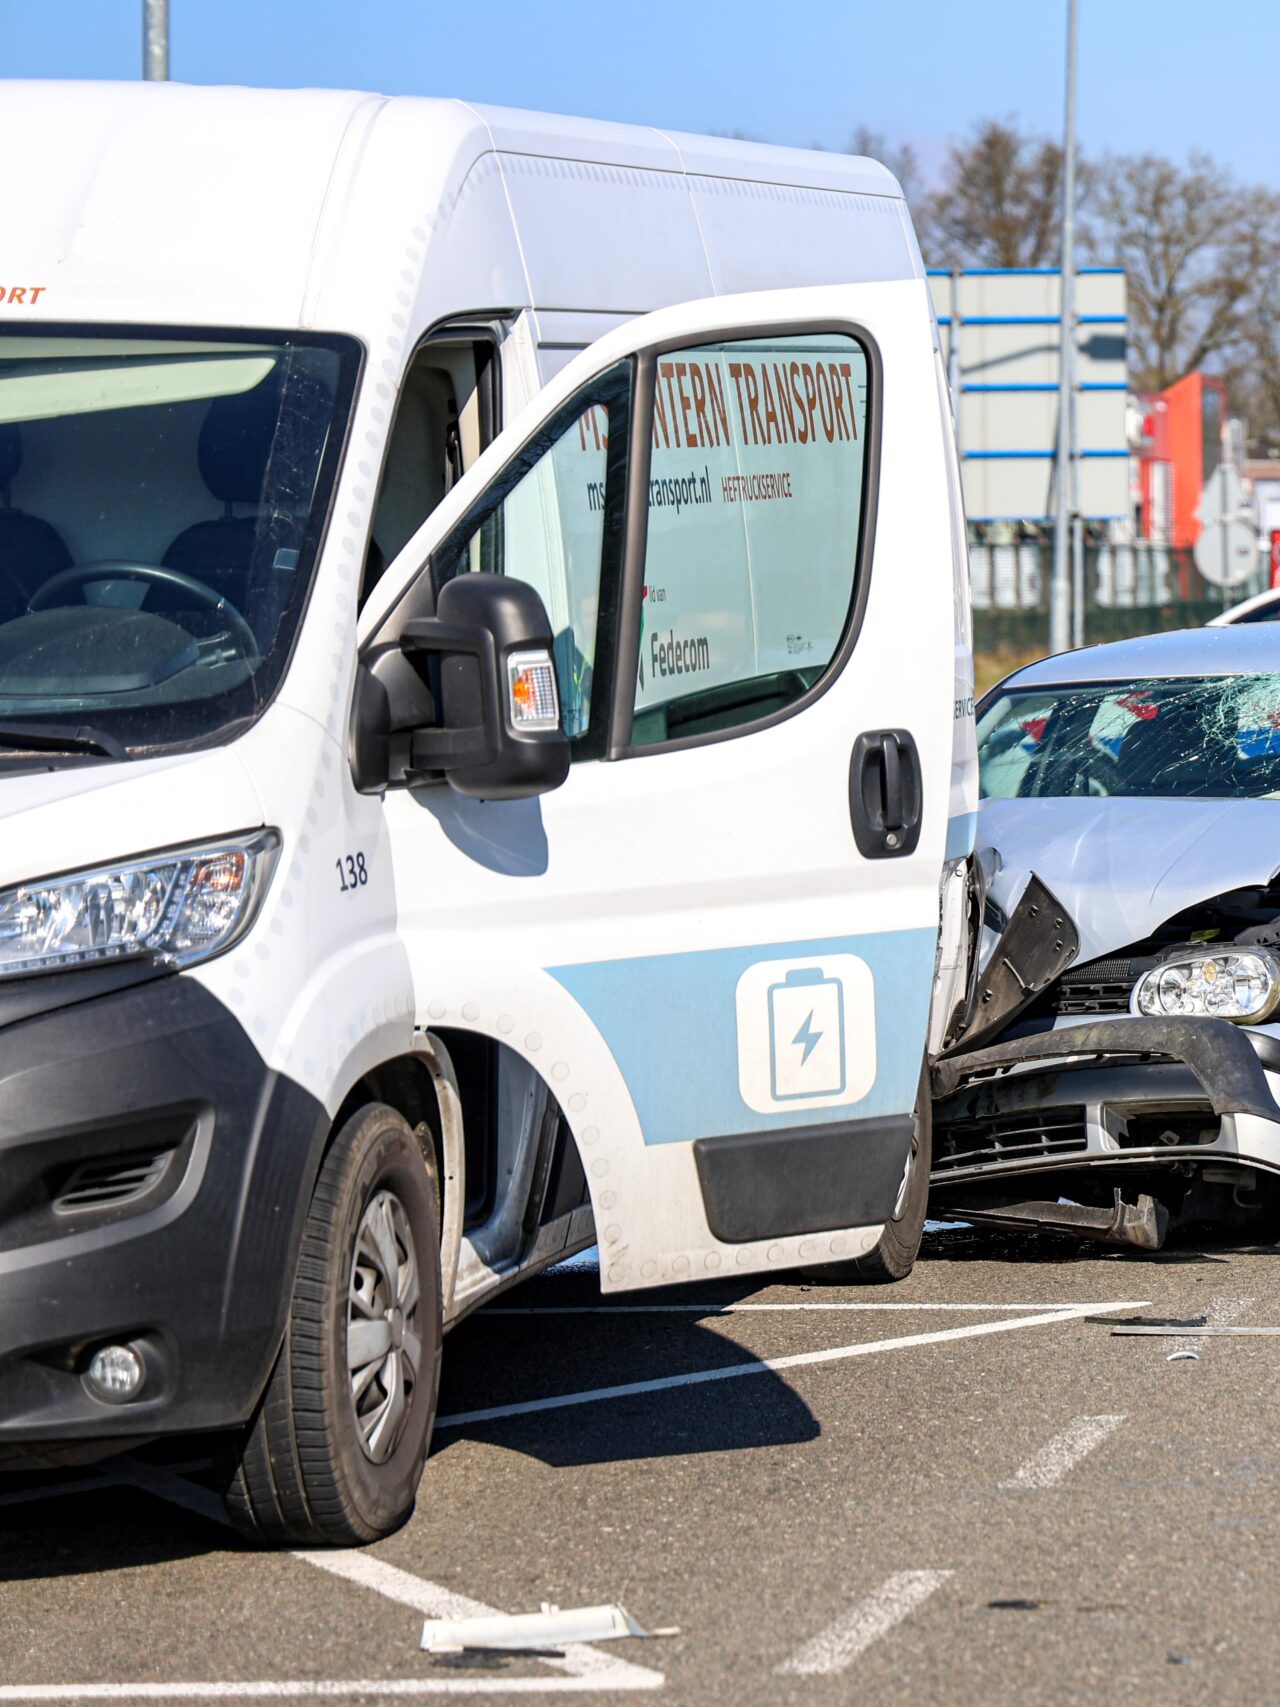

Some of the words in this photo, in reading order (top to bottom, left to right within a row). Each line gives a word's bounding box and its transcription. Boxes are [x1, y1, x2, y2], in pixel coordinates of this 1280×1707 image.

[729, 362, 857, 446] TRANSPORT
[721, 472, 792, 503] HEFTRUCKSERVICE
[651, 629, 709, 678] Fedecom
[336, 851, 368, 892] 138
